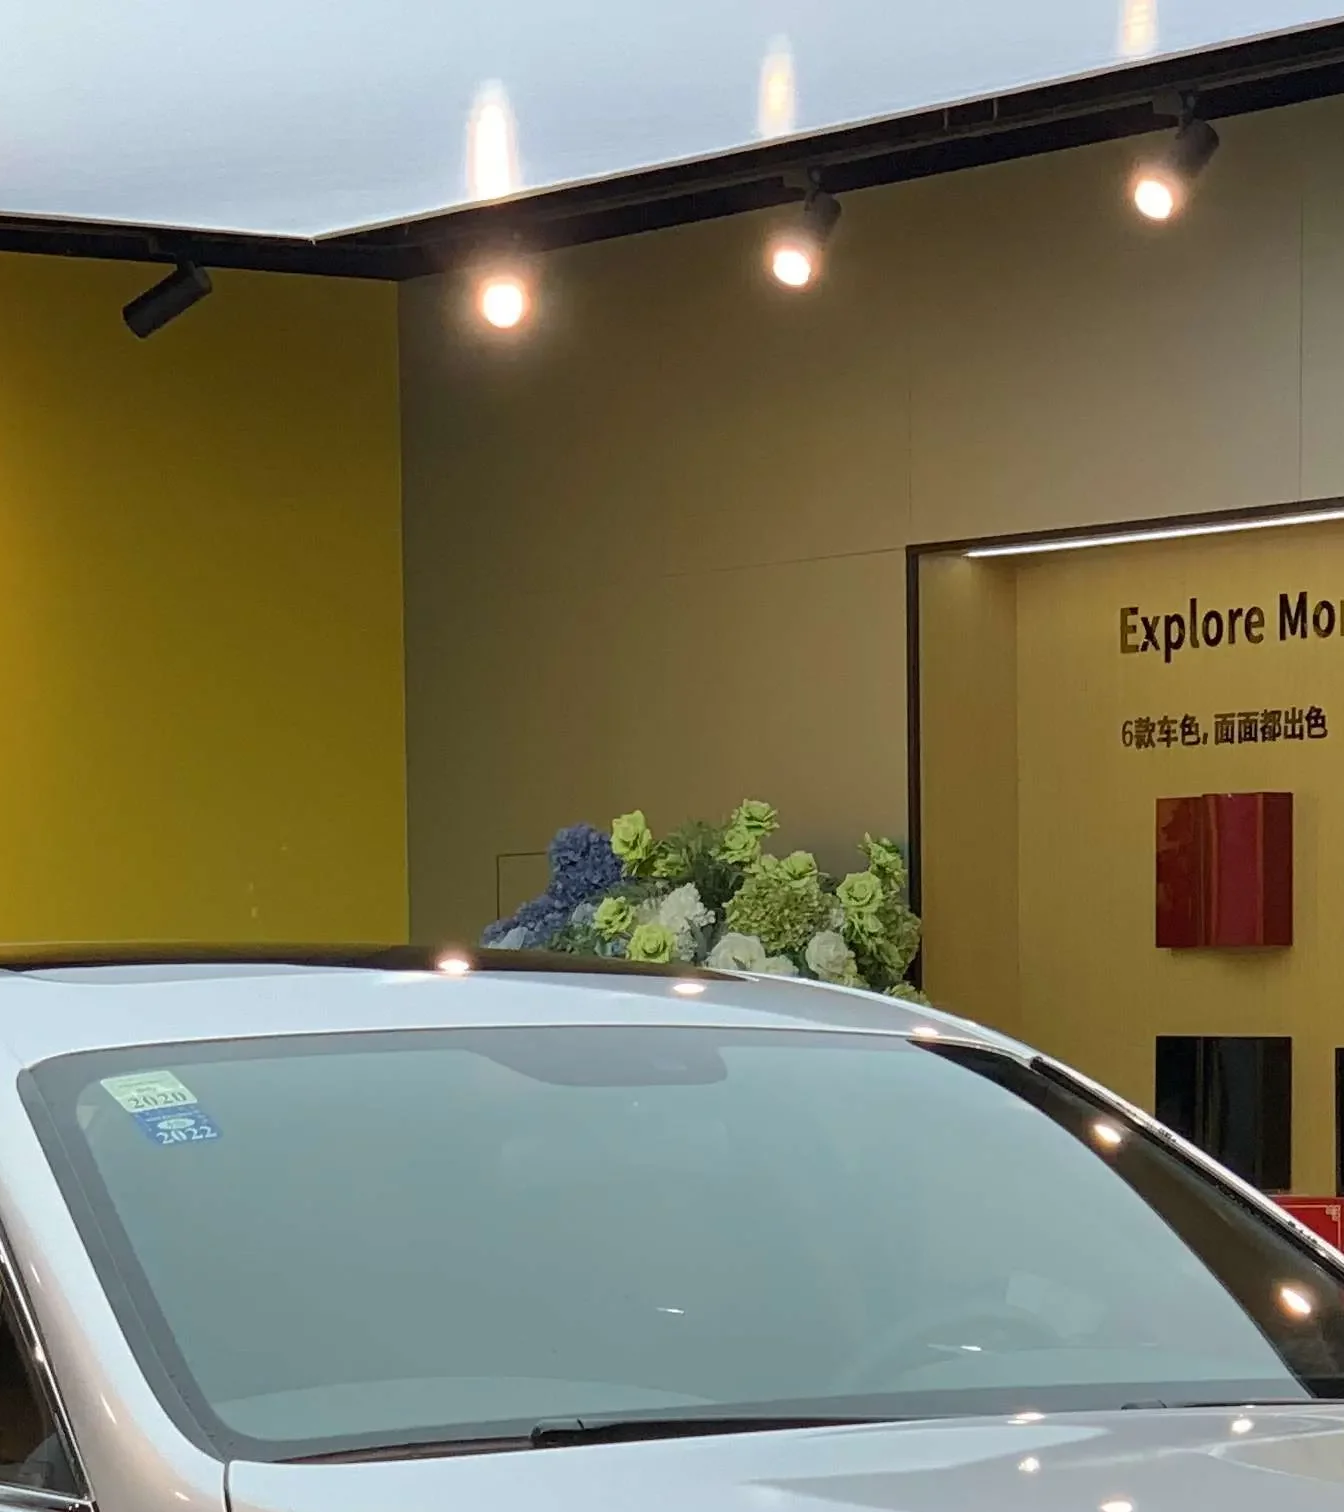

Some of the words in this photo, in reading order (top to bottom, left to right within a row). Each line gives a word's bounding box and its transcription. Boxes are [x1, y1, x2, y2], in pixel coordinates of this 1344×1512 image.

[1119, 597, 1265, 663] Explore
[129, 1091, 187, 1109] 2020
[156, 1126, 218, 1145] 2022
